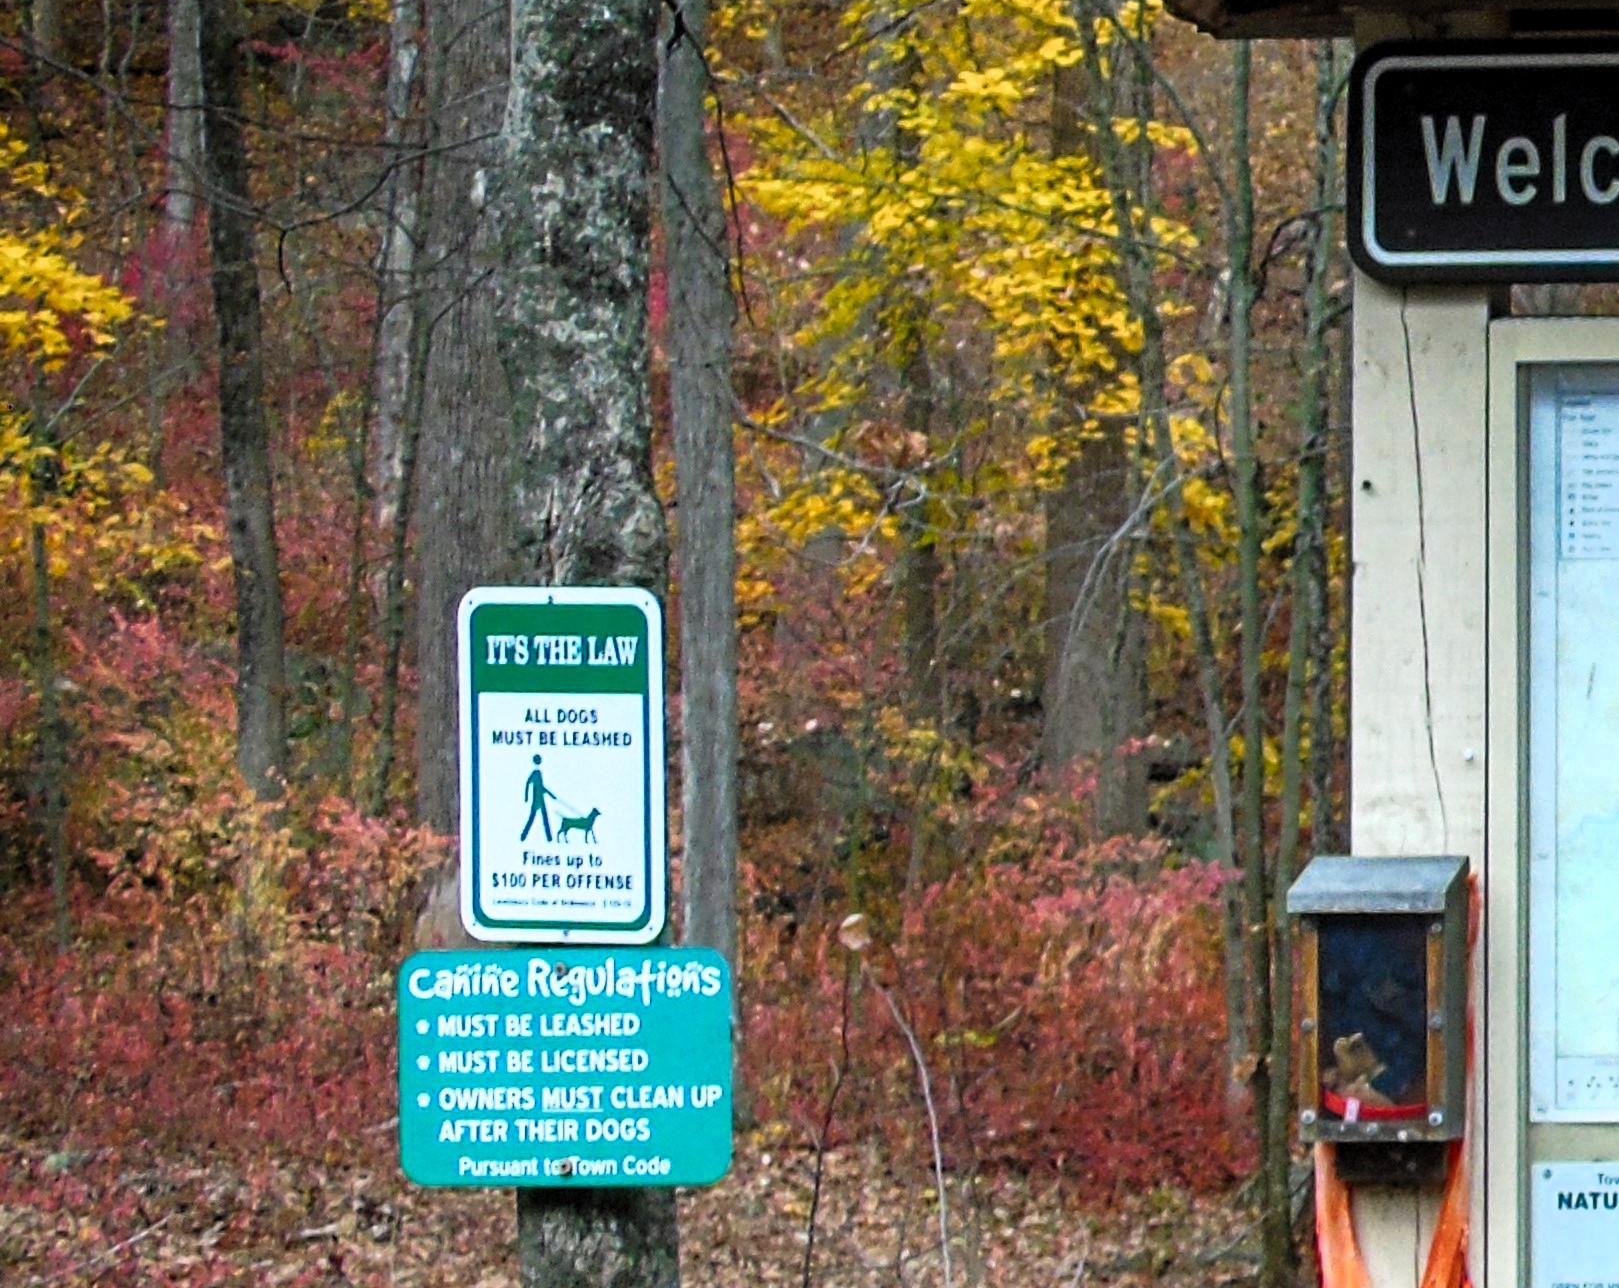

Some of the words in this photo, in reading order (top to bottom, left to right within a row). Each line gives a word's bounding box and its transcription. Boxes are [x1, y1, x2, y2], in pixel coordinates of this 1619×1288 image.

[486, 635, 529, 666] IT'S
[533, 635, 582, 666] THE
[587, 635, 638, 666] LAW
[525, 708, 551, 724] ALL
[557, 708, 598, 724] DOGS
[492, 731, 532, 746] MUST
[539, 731, 557, 746] BE
[563, 731, 633, 746] LEASHED
[522, 851, 560, 866] Fines
[566, 855, 584, 869] up
[589, 852, 603, 866] to
[492, 873, 527, 890] $100
[532, 873, 561, 890] PER
[566, 873, 633, 890] OFFENSE
[408, 963, 520, 1000] Canine
[527, 957, 722, 1007] Regulations
[438, 1013, 499, 1037] MUST
[505, 1013, 533, 1037] BE
[540, 1013, 640, 1037] LEASHED
[439, 1049, 500, 1073] MUST
[506, 1049, 534, 1073] BE
[541, 1049, 648, 1073] LICENSED
[438, 1087, 535, 1110] OWNERS
[542, 1086, 604, 1112] MUST
[610, 1085, 684, 1109] CLEAN
[691, 1085, 723, 1108] UP
[439, 1118, 508, 1142] AFTER
[514, 1118, 579, 1142] THEIR
[585, 1118, 651, 1142] DOGS
[459, 1155, 538, 1176] Pursuant
[544, 1155, 564, 1176] to
[568, 1155, 618, 1176] Town
[622, 1155, 671, 1176] Code
